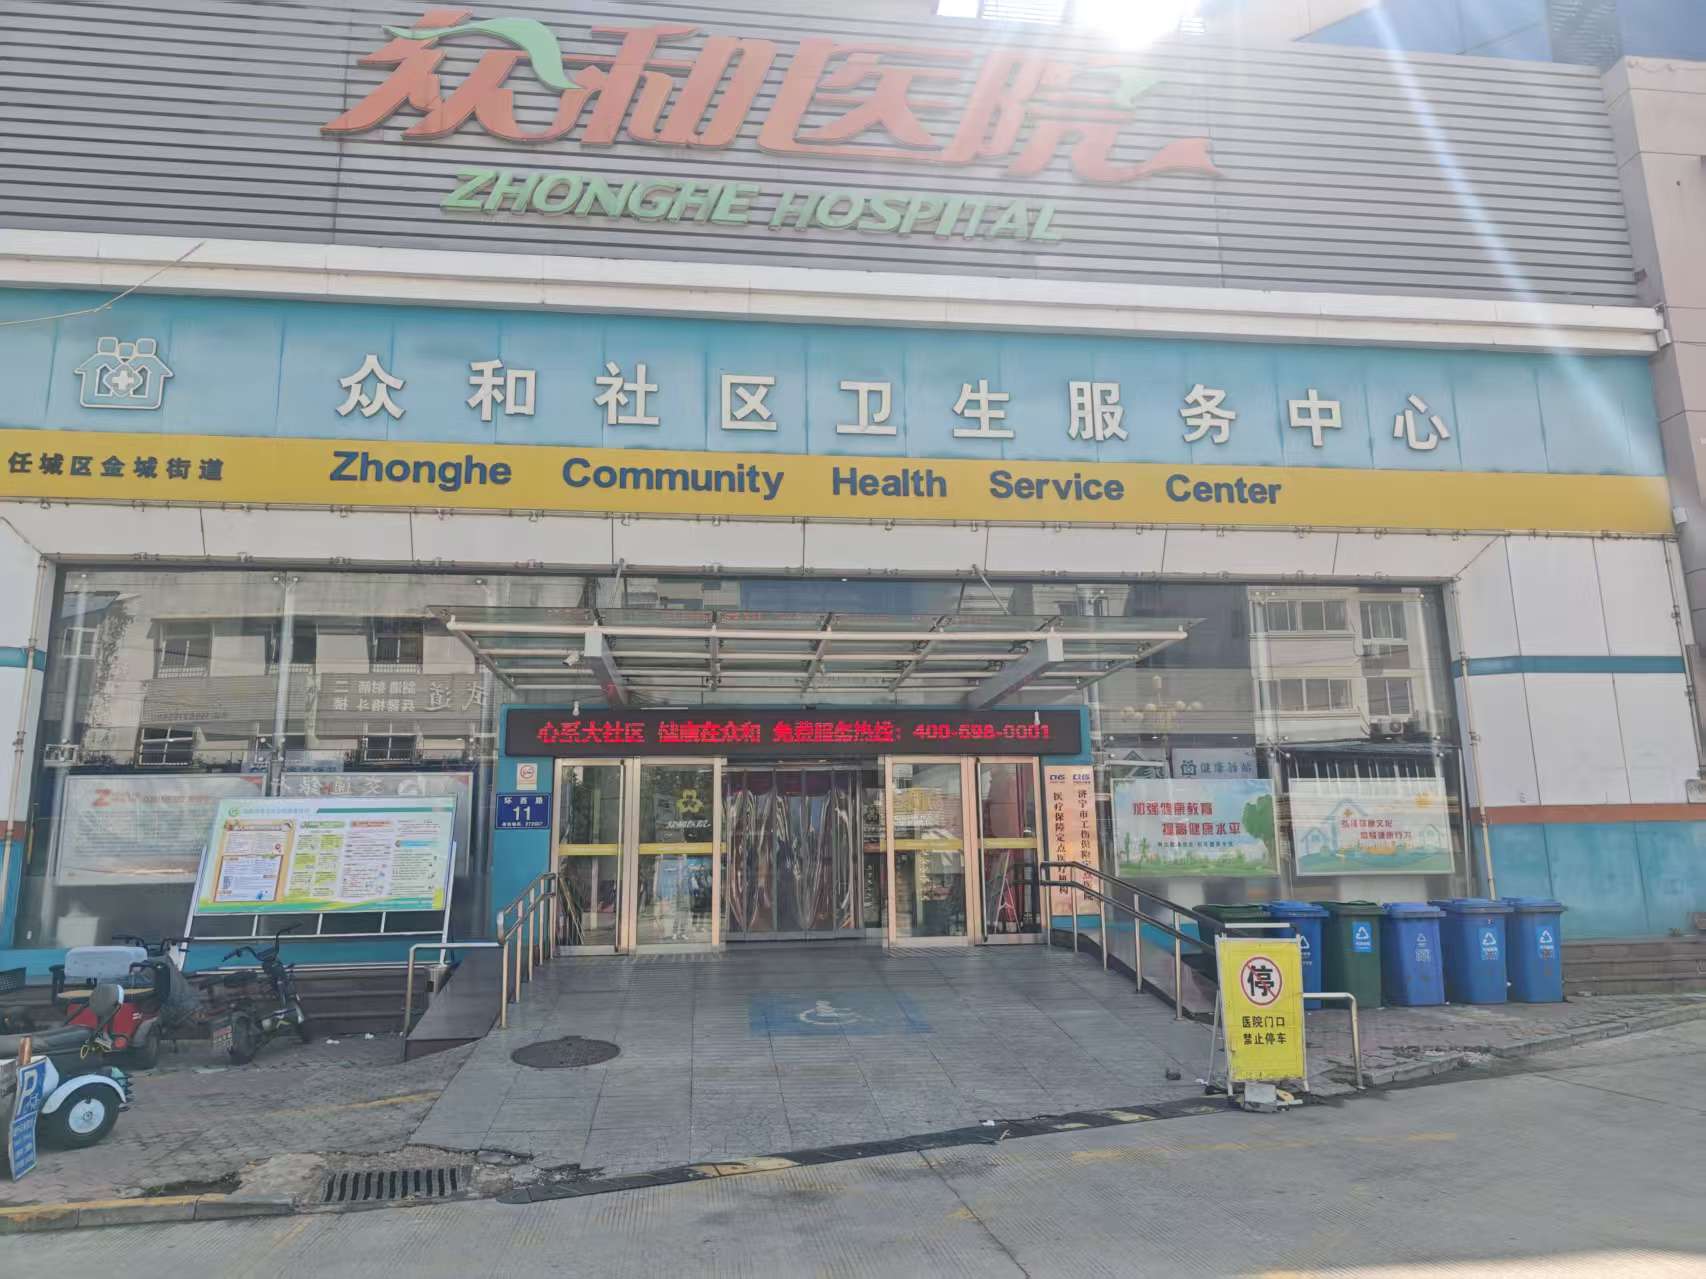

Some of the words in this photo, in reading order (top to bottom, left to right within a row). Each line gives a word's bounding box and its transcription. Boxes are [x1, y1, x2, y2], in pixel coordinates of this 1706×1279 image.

[319, 8, 1226, 184] 众和医院
[440, 168, 760, 225] ZHONGHE
[768, 186, 1064, 241] HOSPITAL
[336, 353, 1451, 451] 众和社区卫生服务中心
[8, 451, 224, 480] 任城区金城街道
[329, 450, 512, 491] Zhonghe
[562, 457, 784, 501] Community
[832, 466, 948, 498] Health
[988, 469, 1125, 500] Service
[1165, 472, 1282, 504] Center
[536, 721, 645, 743] 心系大社区
[658, 721, 761, 743] 健康在众和
[512, 806, 531, 821] 11
[1133, 802, 1213, 816] 加强健康教育
[1162, 822, 1241, 836] 提高健康水平
[1247, 965, 1275, 997] 停
[1242, 1015, 1286, 1028] 医院门口
[1243, 1033, 1288, 1046] 禁止停车
